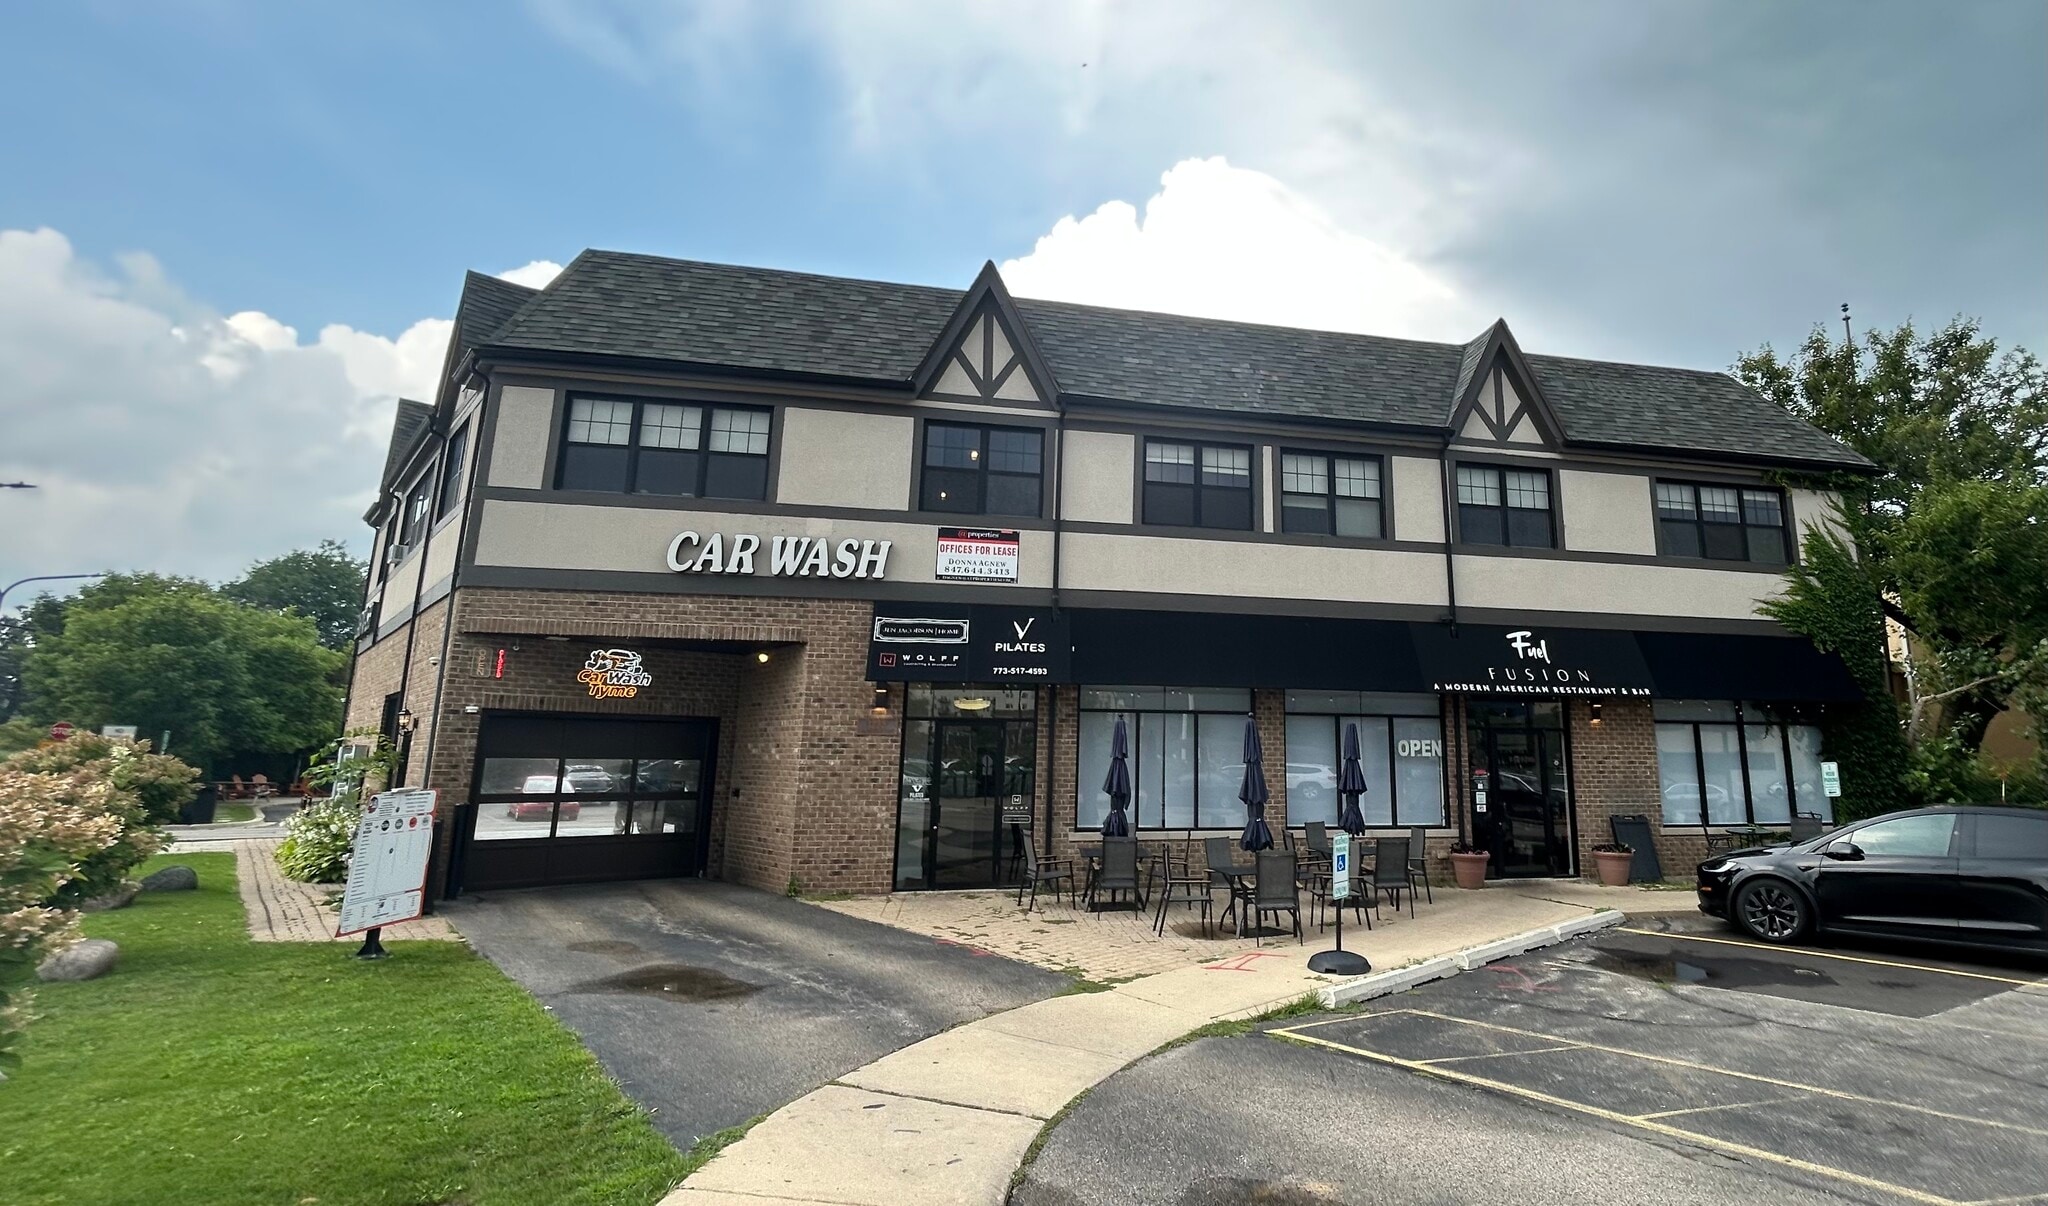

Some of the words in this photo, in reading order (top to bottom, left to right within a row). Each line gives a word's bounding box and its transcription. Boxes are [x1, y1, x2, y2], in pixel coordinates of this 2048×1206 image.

[666, 530, 760, 574] CAR
[771, 535, 892, 579] WASH
[940, 543, 973, 554] OFFICES
[975, 546, 991, 555] FOR
[993, 547, 1017, 556] LEASE
[948, 558, 977, 566] DONNA
[944, 566, 1010, 576] 847.644.3413
[995, 642, 1046, 652] PILATES
[1506, 630, 1551, 664] Fuel
[902, 654, 959, 662] WOLFF
[993, 667, 1048, 675] 773-517-4593
[1488, 667, 1590, 681] FUSION
[588, 683, 637, 699] Tyme
[1444, 683, 1490, 692] MODERN
[1495, 685, 1550, 693] AMERICAN
[1552, 686, 1617, 695] RESTAURANT
[1621, 687, 1628, 695] &
[1398, 739, 1442, 757] OPEN
